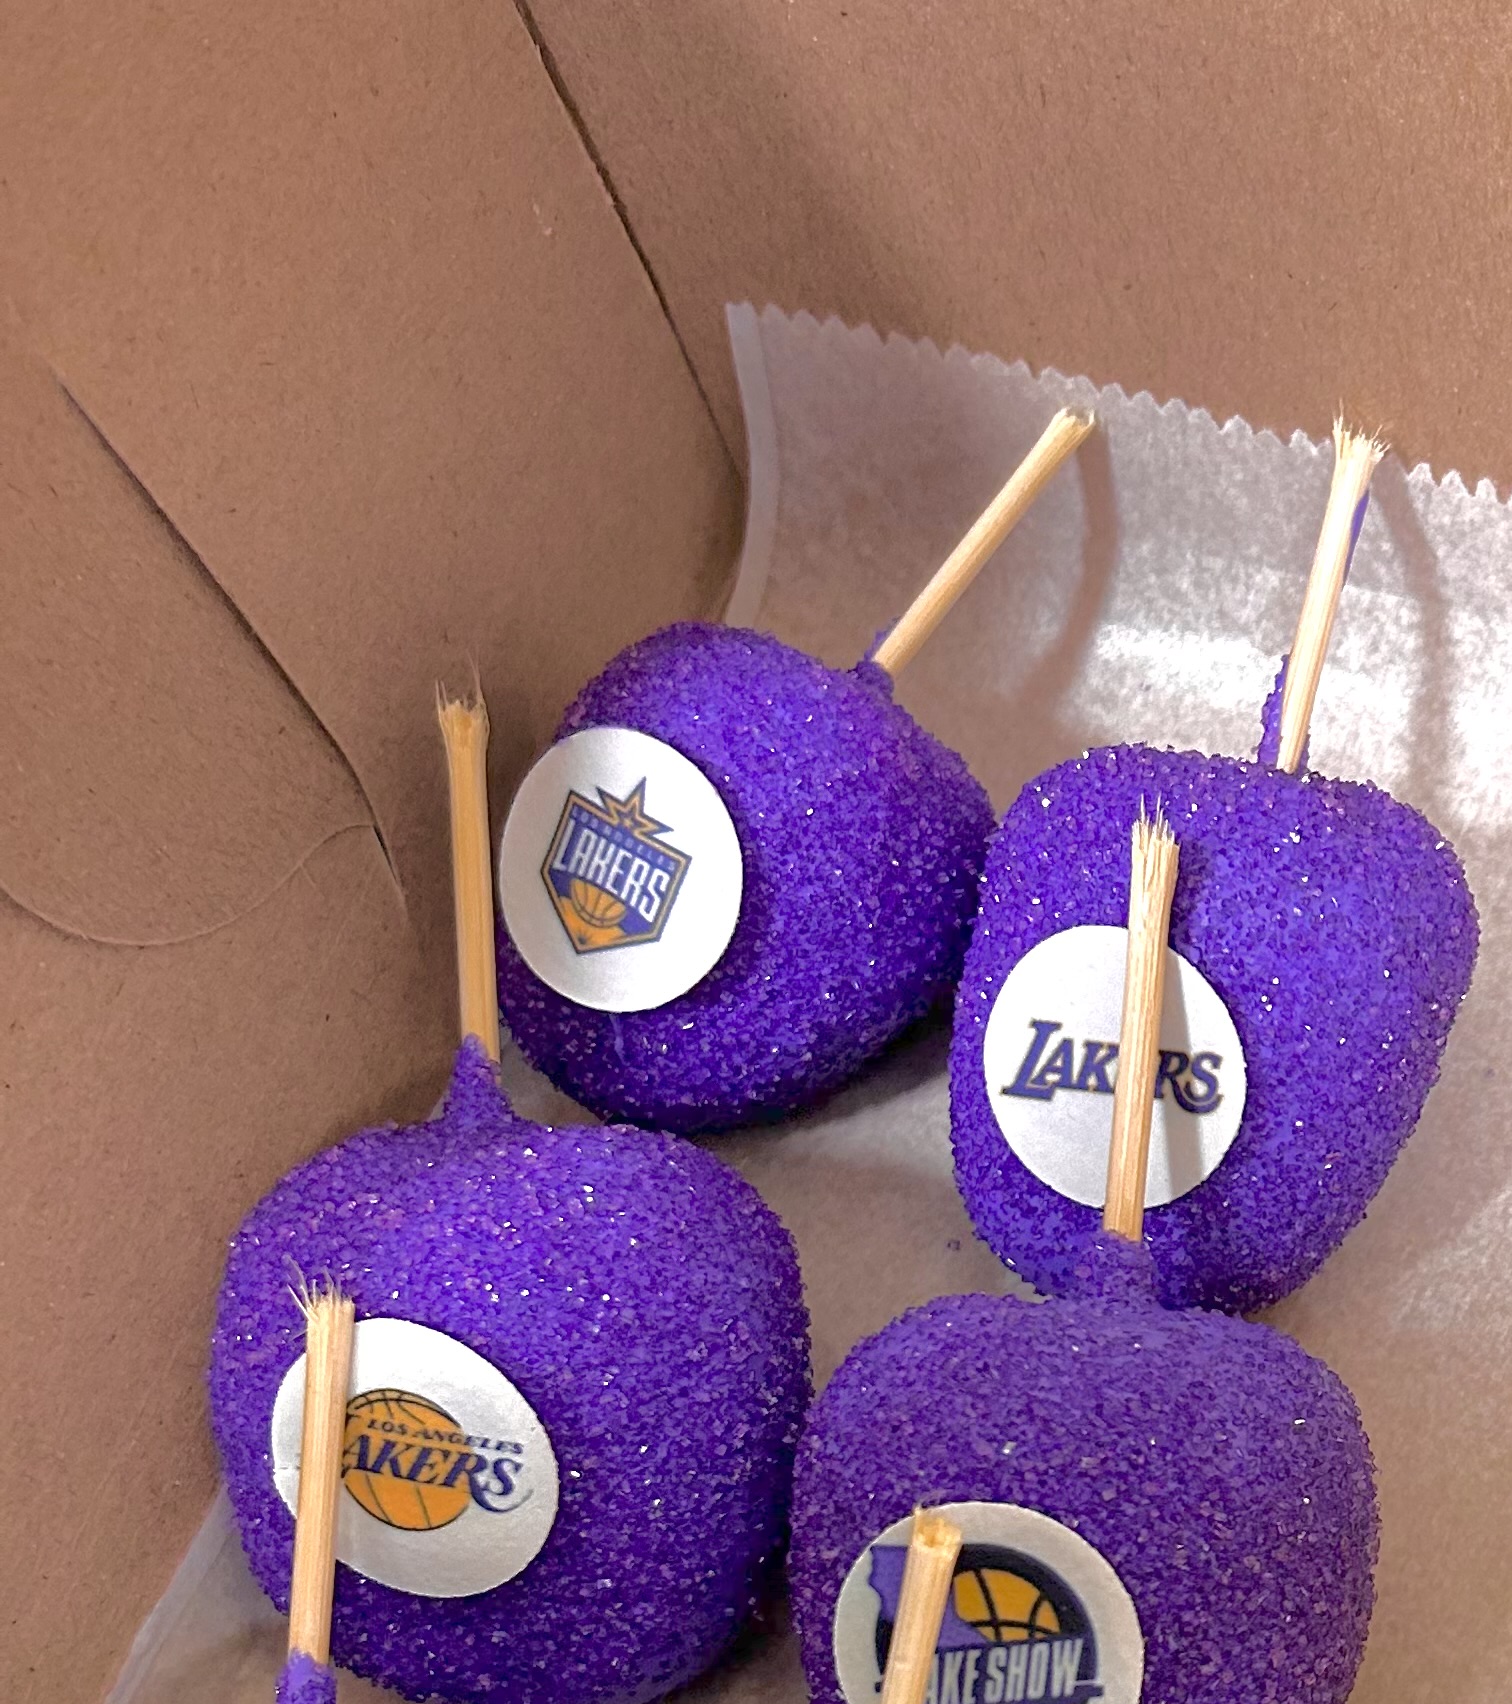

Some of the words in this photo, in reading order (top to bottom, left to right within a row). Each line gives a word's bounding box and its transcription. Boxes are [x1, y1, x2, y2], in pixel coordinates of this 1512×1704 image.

[552, 819, 670, 923] LAKERS
[1000, 1017, 1224, 1114] LAKRS
[341, 1433, 534, 1513] AKERS
[367, 1418, 407, 1437] LOS
[411, 1427, 525, 1455] ANGELES
